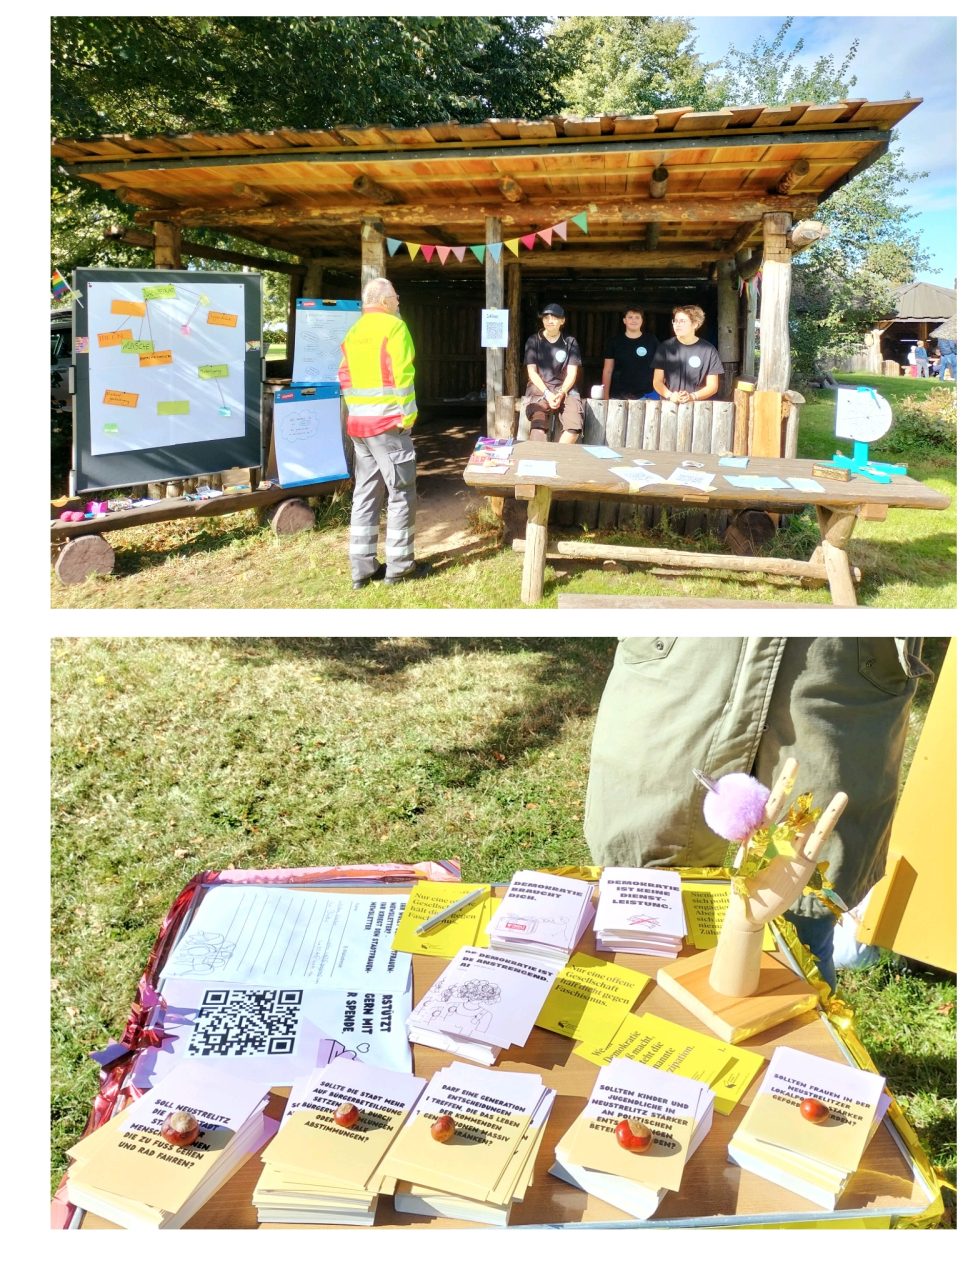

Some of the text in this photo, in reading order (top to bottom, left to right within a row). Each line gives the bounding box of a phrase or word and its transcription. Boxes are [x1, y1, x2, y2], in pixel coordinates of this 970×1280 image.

[415, 893, 430, 901] Nur
[508, 893, 537, 901] DICH.
[511, 887, 562, 899] BRAUCHT
[513, 881, 584, 897] DEMOKRATIE
[607, 880, 680, 892] DEMOKRATIE
[636, 888, 671, 896] KEINE
[476, 958, 549, 982] ANSTRENGEND.
[479, 953, 538, 972] DEMOKRATIE
[537, 968, 554, 977] IST
[565, 971, 620, 993] Gesellschaft
[571, 965, 635, 989] Nur eine offene
[555, 984, 608, 1007] Faschismus.
[602, 992, 630, 1005] gegen
[361, 993, 375, 1035] GERN MIT
[380, 994, 394, 1033] RSTÜTZT
[652, 1041, 664, 1053] die
[319, 1081, 346, 1092] SOLLTE
[360, 1091, 383, 1101] STADT
[384, 1098, 406, 1109] MEHR
[441, 1084, 526, 1113] DARF EINE GENERATION
[599, 1084, 689, 1110] SOLLTEN KINDER UND
[774, 1073, 807, 1088] SOLLTEN
[809, 1085, 841, 1099] FRAUEN
[855, 1100, 871, 1109] DER
[787, 1085, 851, 1109] NEUSTRELITZER
[152, 1108, 167, 1116] DIE
[154, 1099, 174, 1109] SOLL
[175, 1104, 231, 1124] NEUSTRELITZ
[329, 1091, 403, 1116] BÜRGERBETEILIGUNG
[447, 1094, 512, 1116] ENTSCHEIDUNGEN
[591, 1098, 649, 1116] NEUSTRELITZ
[601, 1109, 615, 1117] AN
[607, 1094, 676, 1115] JUGENDLICHE IN
[315, 1114, 334, 1124] ODER
[439, 1108, 503, 1131] DER KOMMENDEN
[465, 1107, 479, 1115] DIE
[480, 1111, 494, 1120] DAS
[495, 1116, 520, 1128] LEBEN
[304, 1121, 370, 1143] ABSTIMMUNGEN?
[480, 1129, 511, 1142] MASSIV
[118, 1141, 195, 1169] UND RAD FAHREN?
[123, 1132, 204, 1160] DIE ZU FUSS GEHEN
